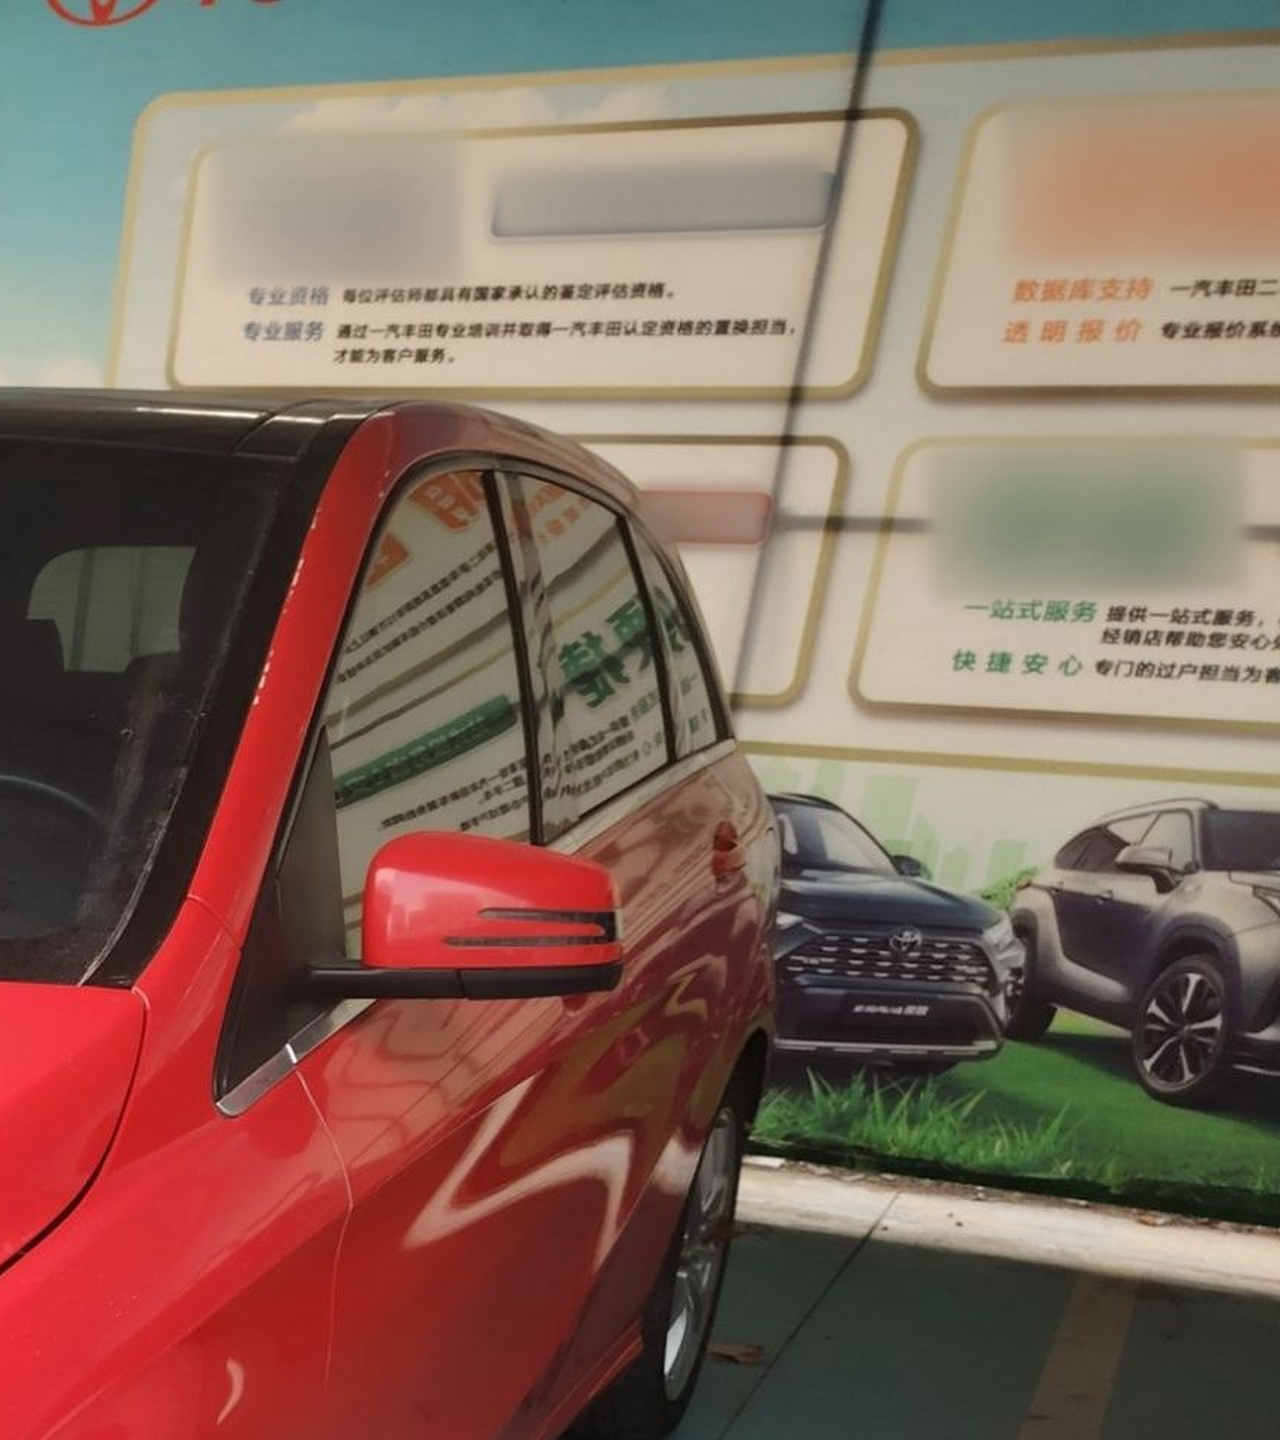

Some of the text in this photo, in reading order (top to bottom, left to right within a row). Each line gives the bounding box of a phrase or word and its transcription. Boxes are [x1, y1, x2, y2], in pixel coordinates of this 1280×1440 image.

[1013, 277, 1154, 302] 数据库支持
[243, 321, 324, 342] 专业服务
[1002, 318, 1143, 344] 透明报价
[964, 599, 1098, 623] 一站式服务
[952, 648, 1082, 677] 快捷安心
